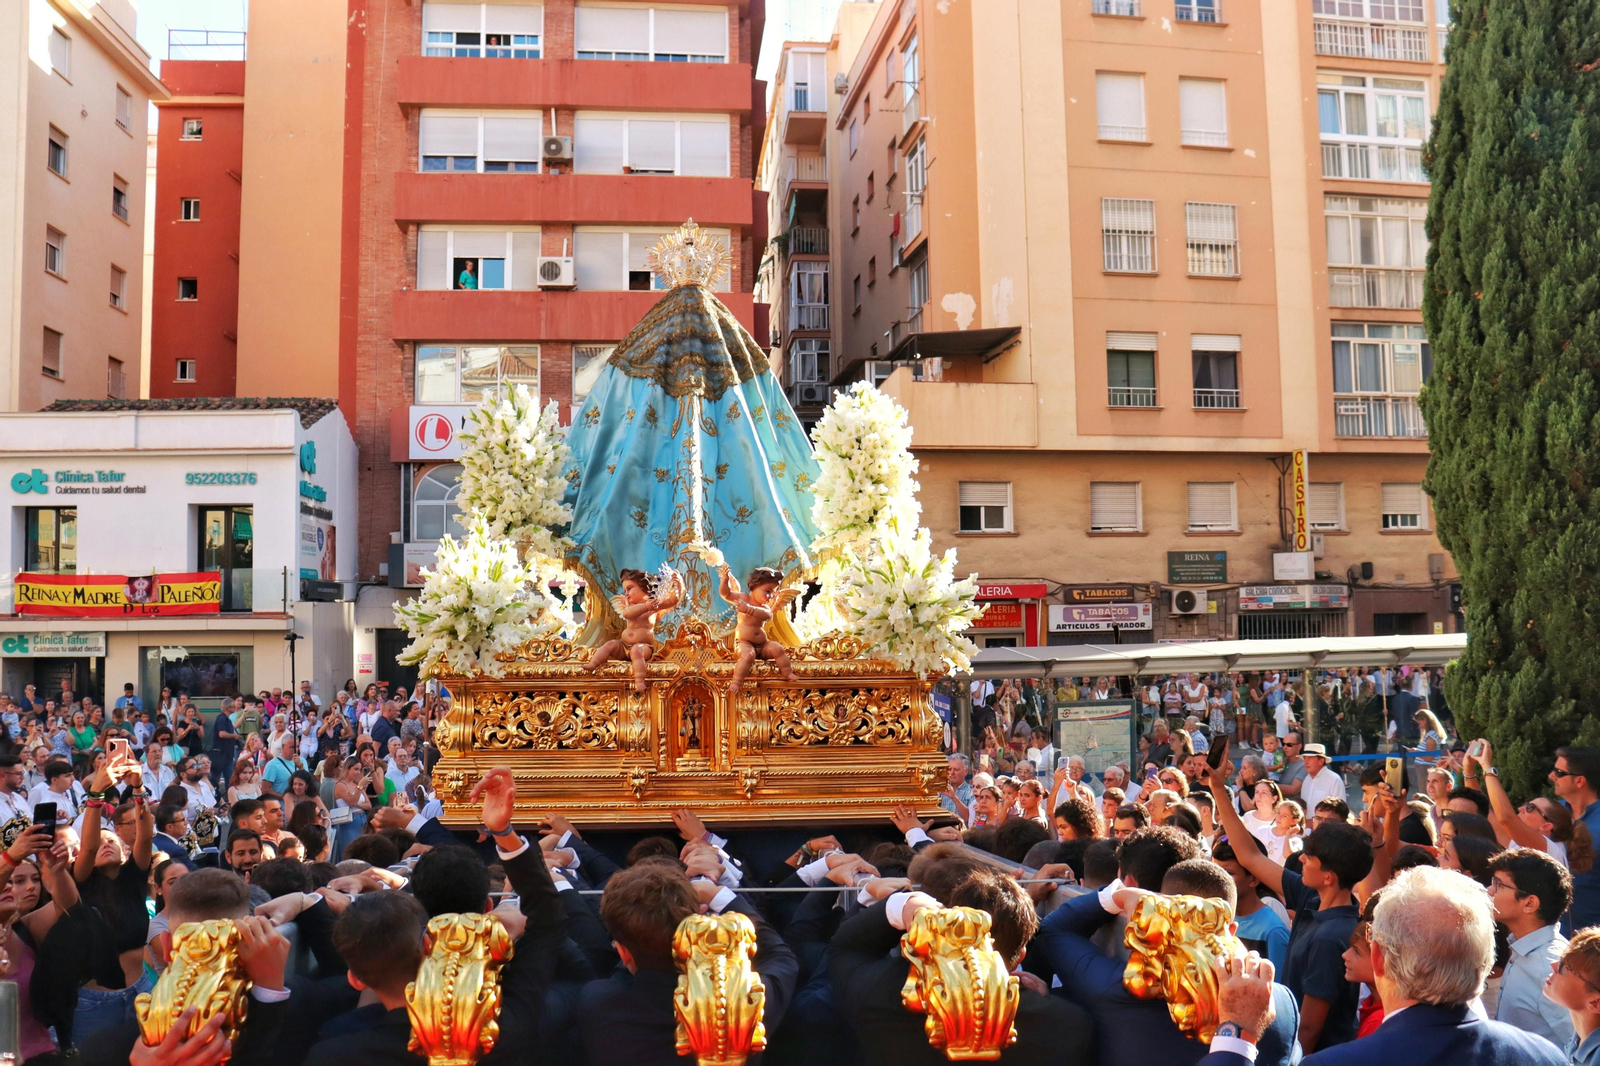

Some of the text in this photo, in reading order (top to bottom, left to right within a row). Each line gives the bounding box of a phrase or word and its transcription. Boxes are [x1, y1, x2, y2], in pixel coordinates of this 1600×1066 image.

[54, 470, 125, 483] Clínica Tafur
[185, 472, 257, 485] 952203376
[55, 486, 146, 494] Cuidamos tu salud dental
[1294, 451, 1307, 550] CASTRO
[1184, 553, 1210, 561] REINA
[18, 584, 62, 602] REINA
[73, 587, 122, 605] MADRE
[1085, 589, 1128, 597] TABACOS
[1087, 608, 1129, 616] TABACOS
[33, 635, 89, 645] Clínica Tafur
